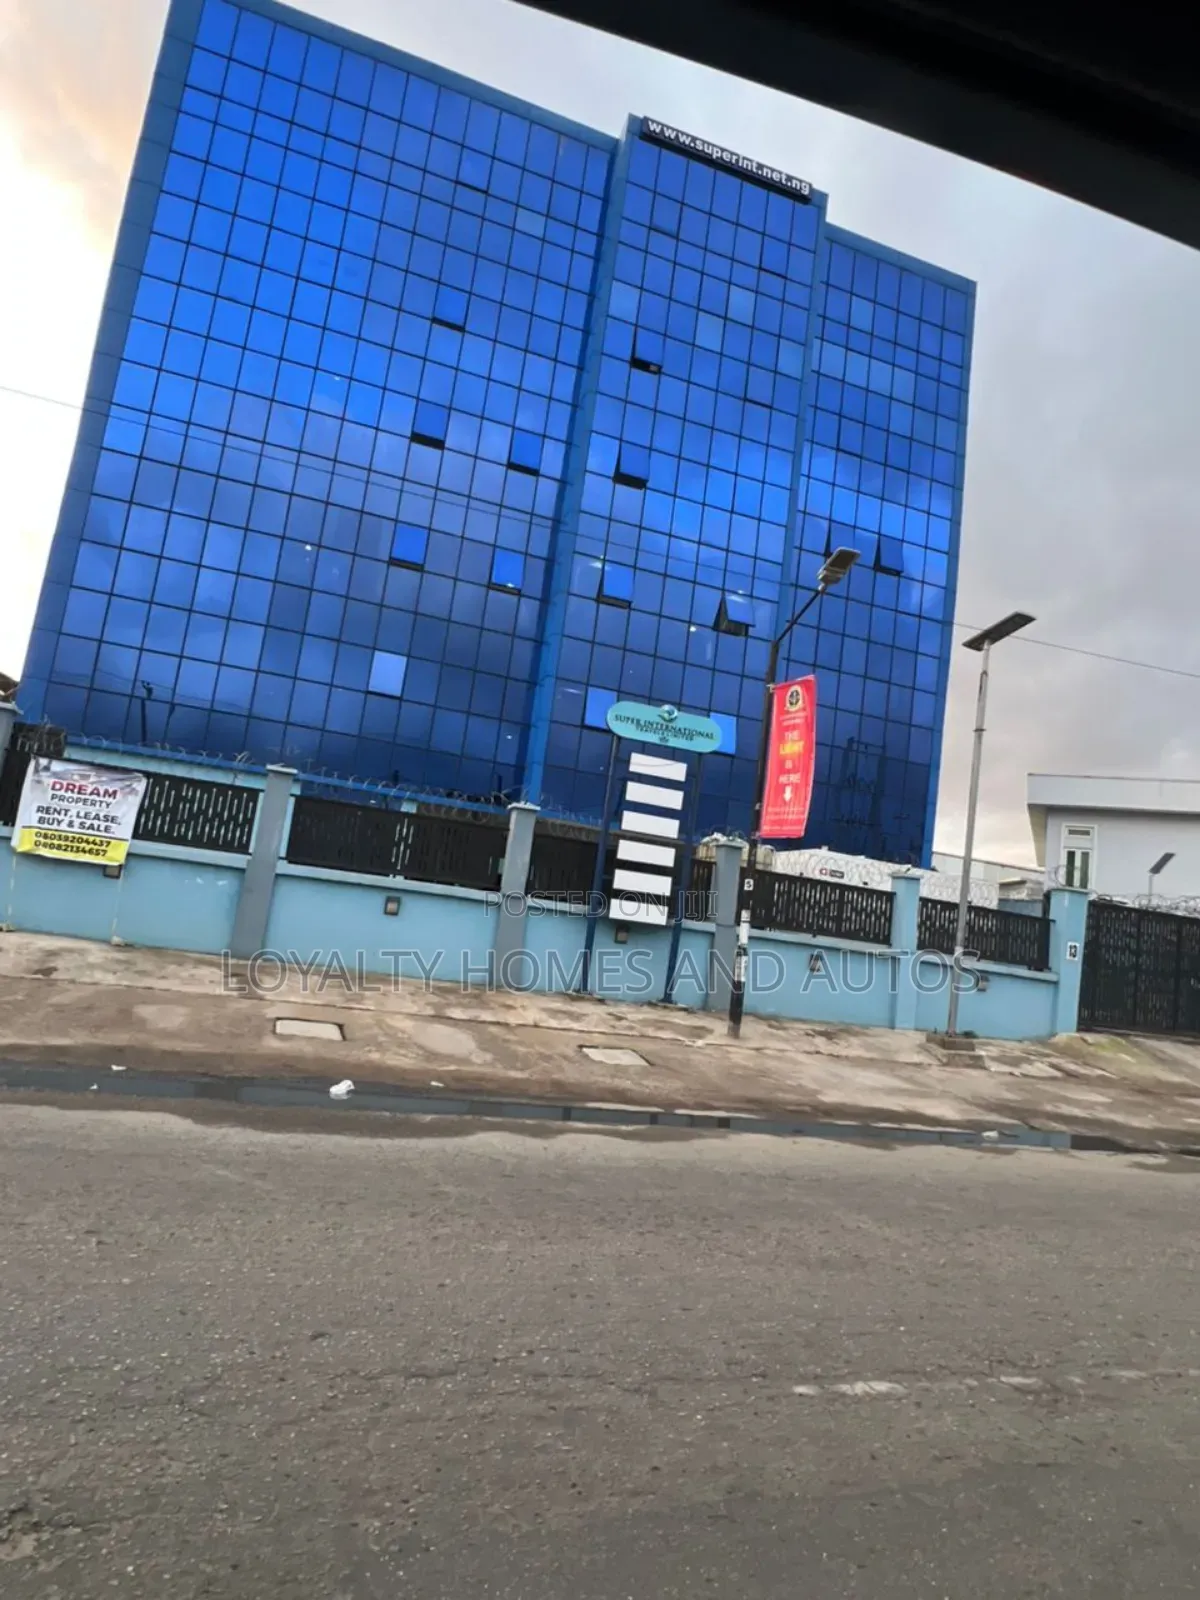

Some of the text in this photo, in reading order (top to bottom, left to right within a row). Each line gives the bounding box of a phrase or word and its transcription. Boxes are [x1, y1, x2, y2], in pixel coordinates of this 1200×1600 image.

[647, 119, 811, 195] www.superint.net.ng
[614, 714, 715, 740] SUPER INTERNATIONAL
[51, 781, 118, 800] DREAM
[50, 793, 112, 809] PROPERTY
[37, 816, 115, 834] BUY & SALE.
